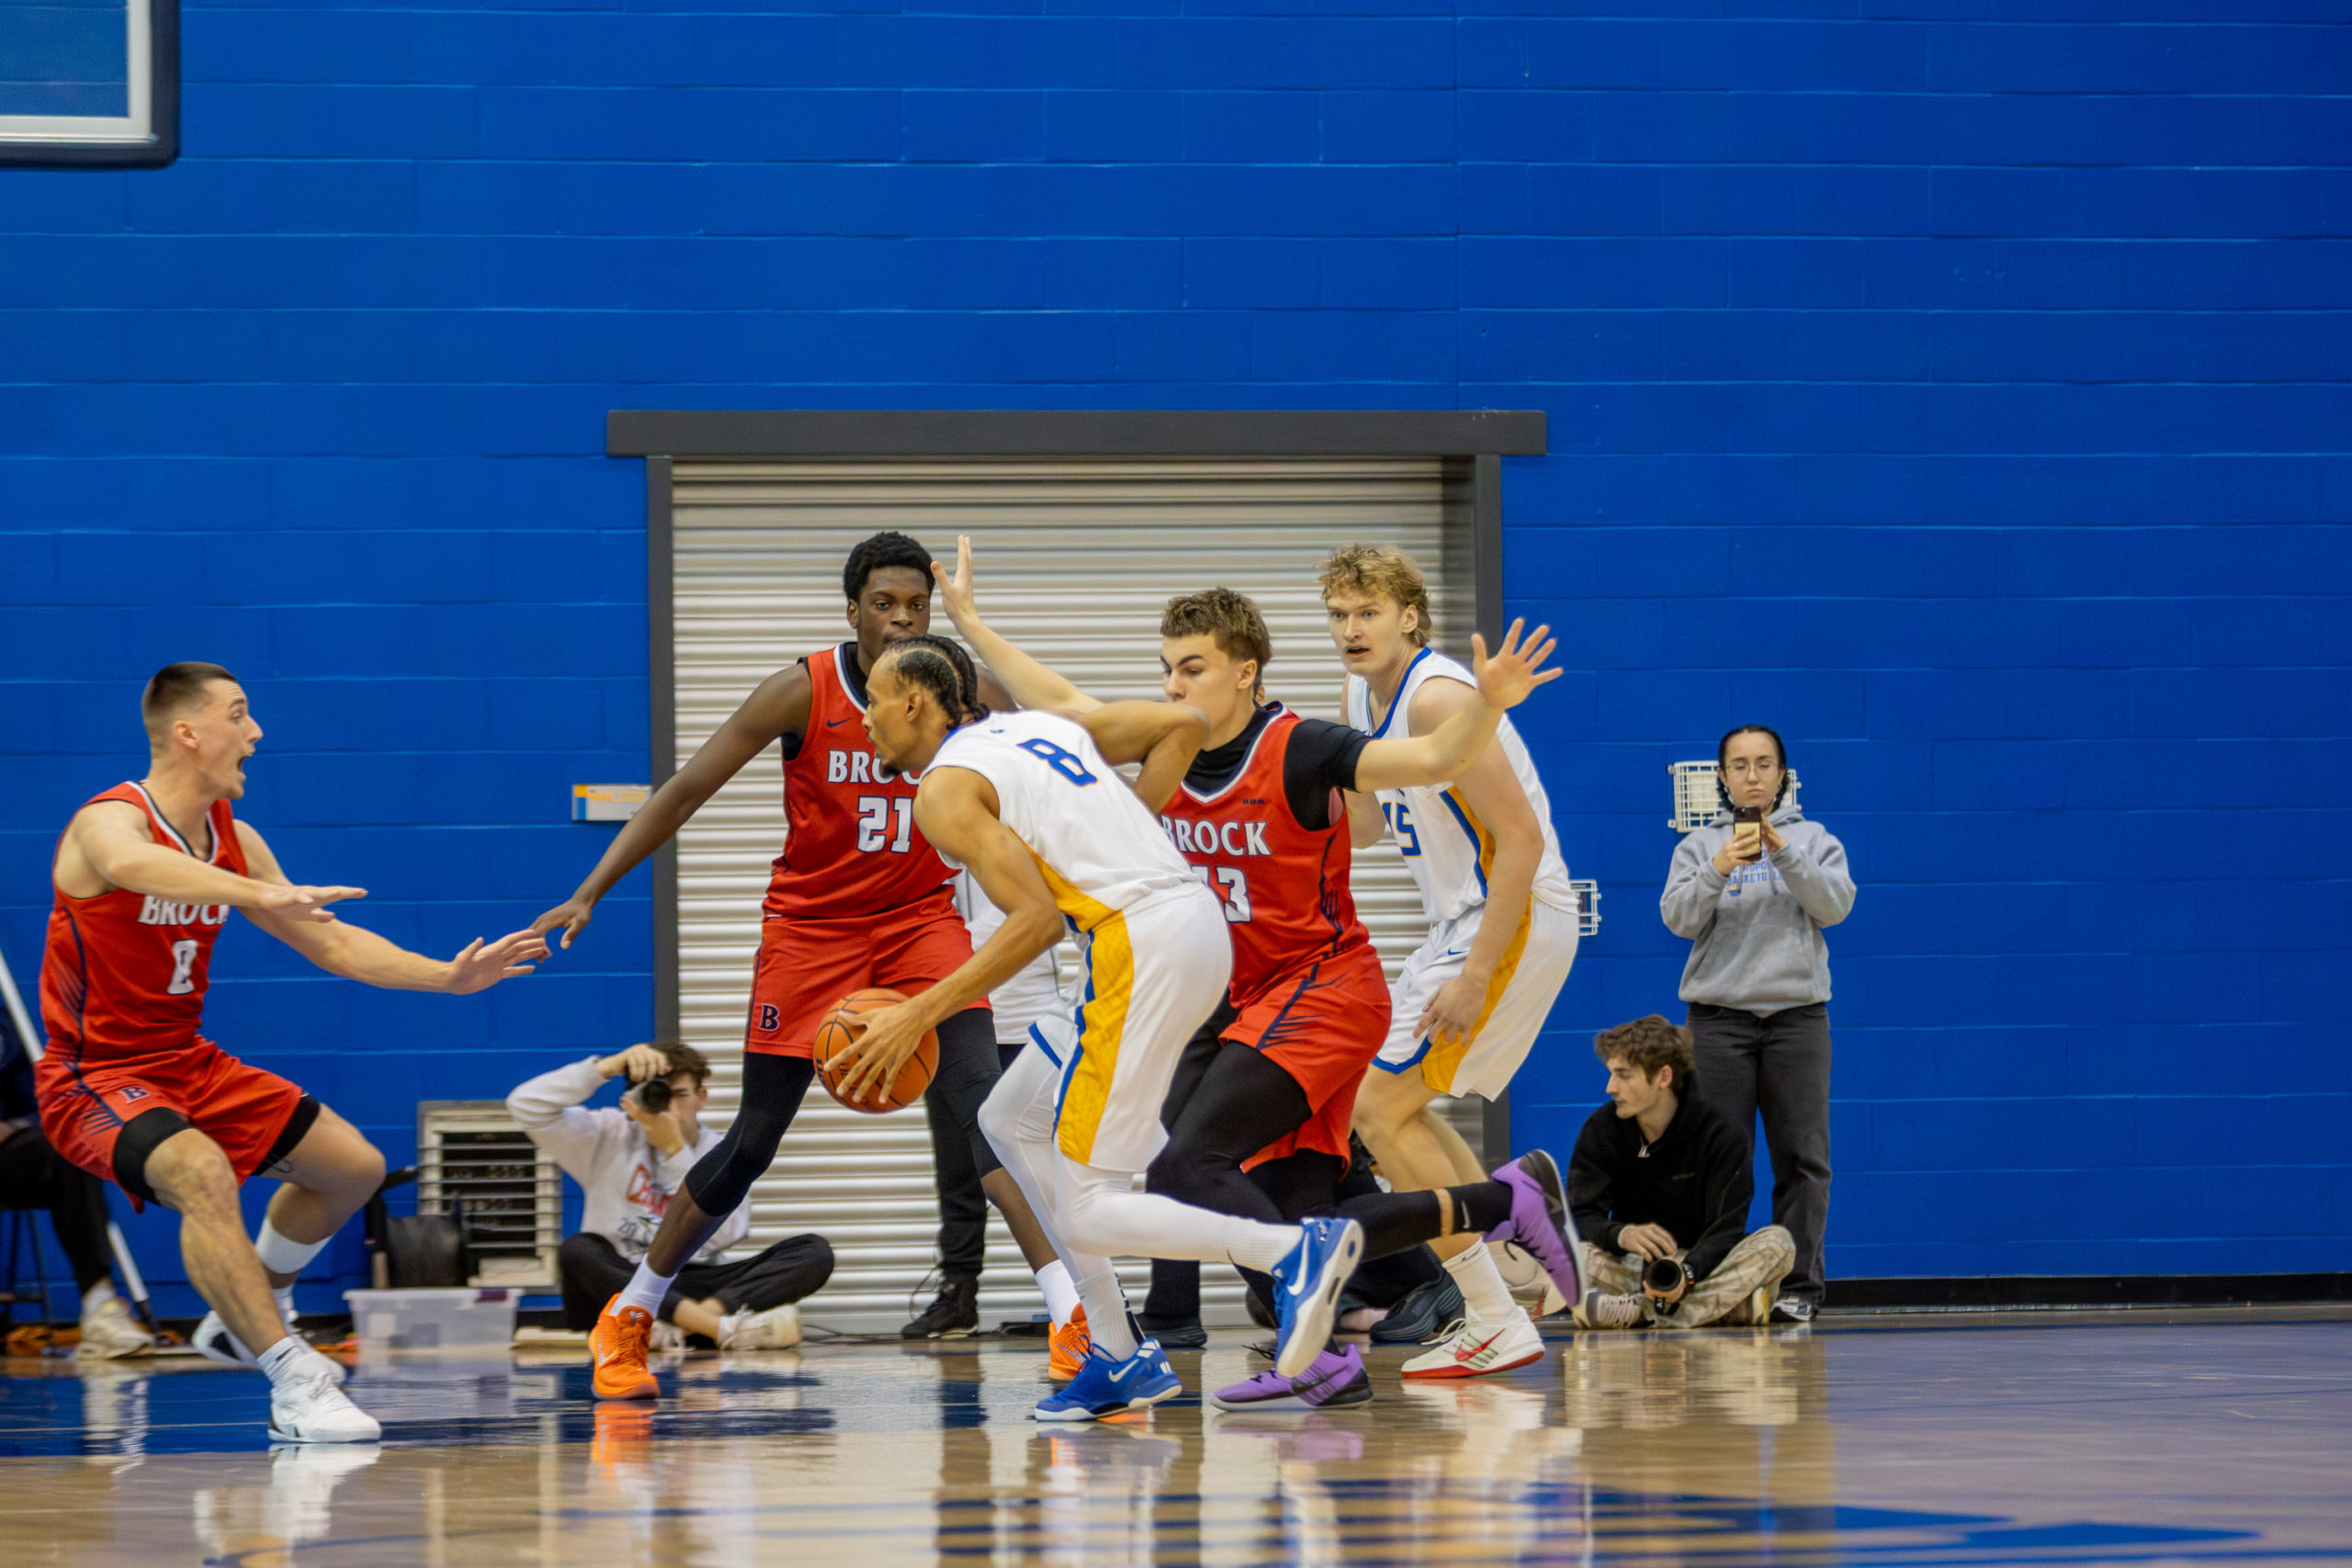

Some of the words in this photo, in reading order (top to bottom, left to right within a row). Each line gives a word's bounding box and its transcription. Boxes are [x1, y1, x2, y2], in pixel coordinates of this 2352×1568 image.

[1015, 738, 1099, 787] 8
[856, 795, 913, 854] 21
[757, 1003, 780, 1032] B
[116, 1085, 151, 1104] B
